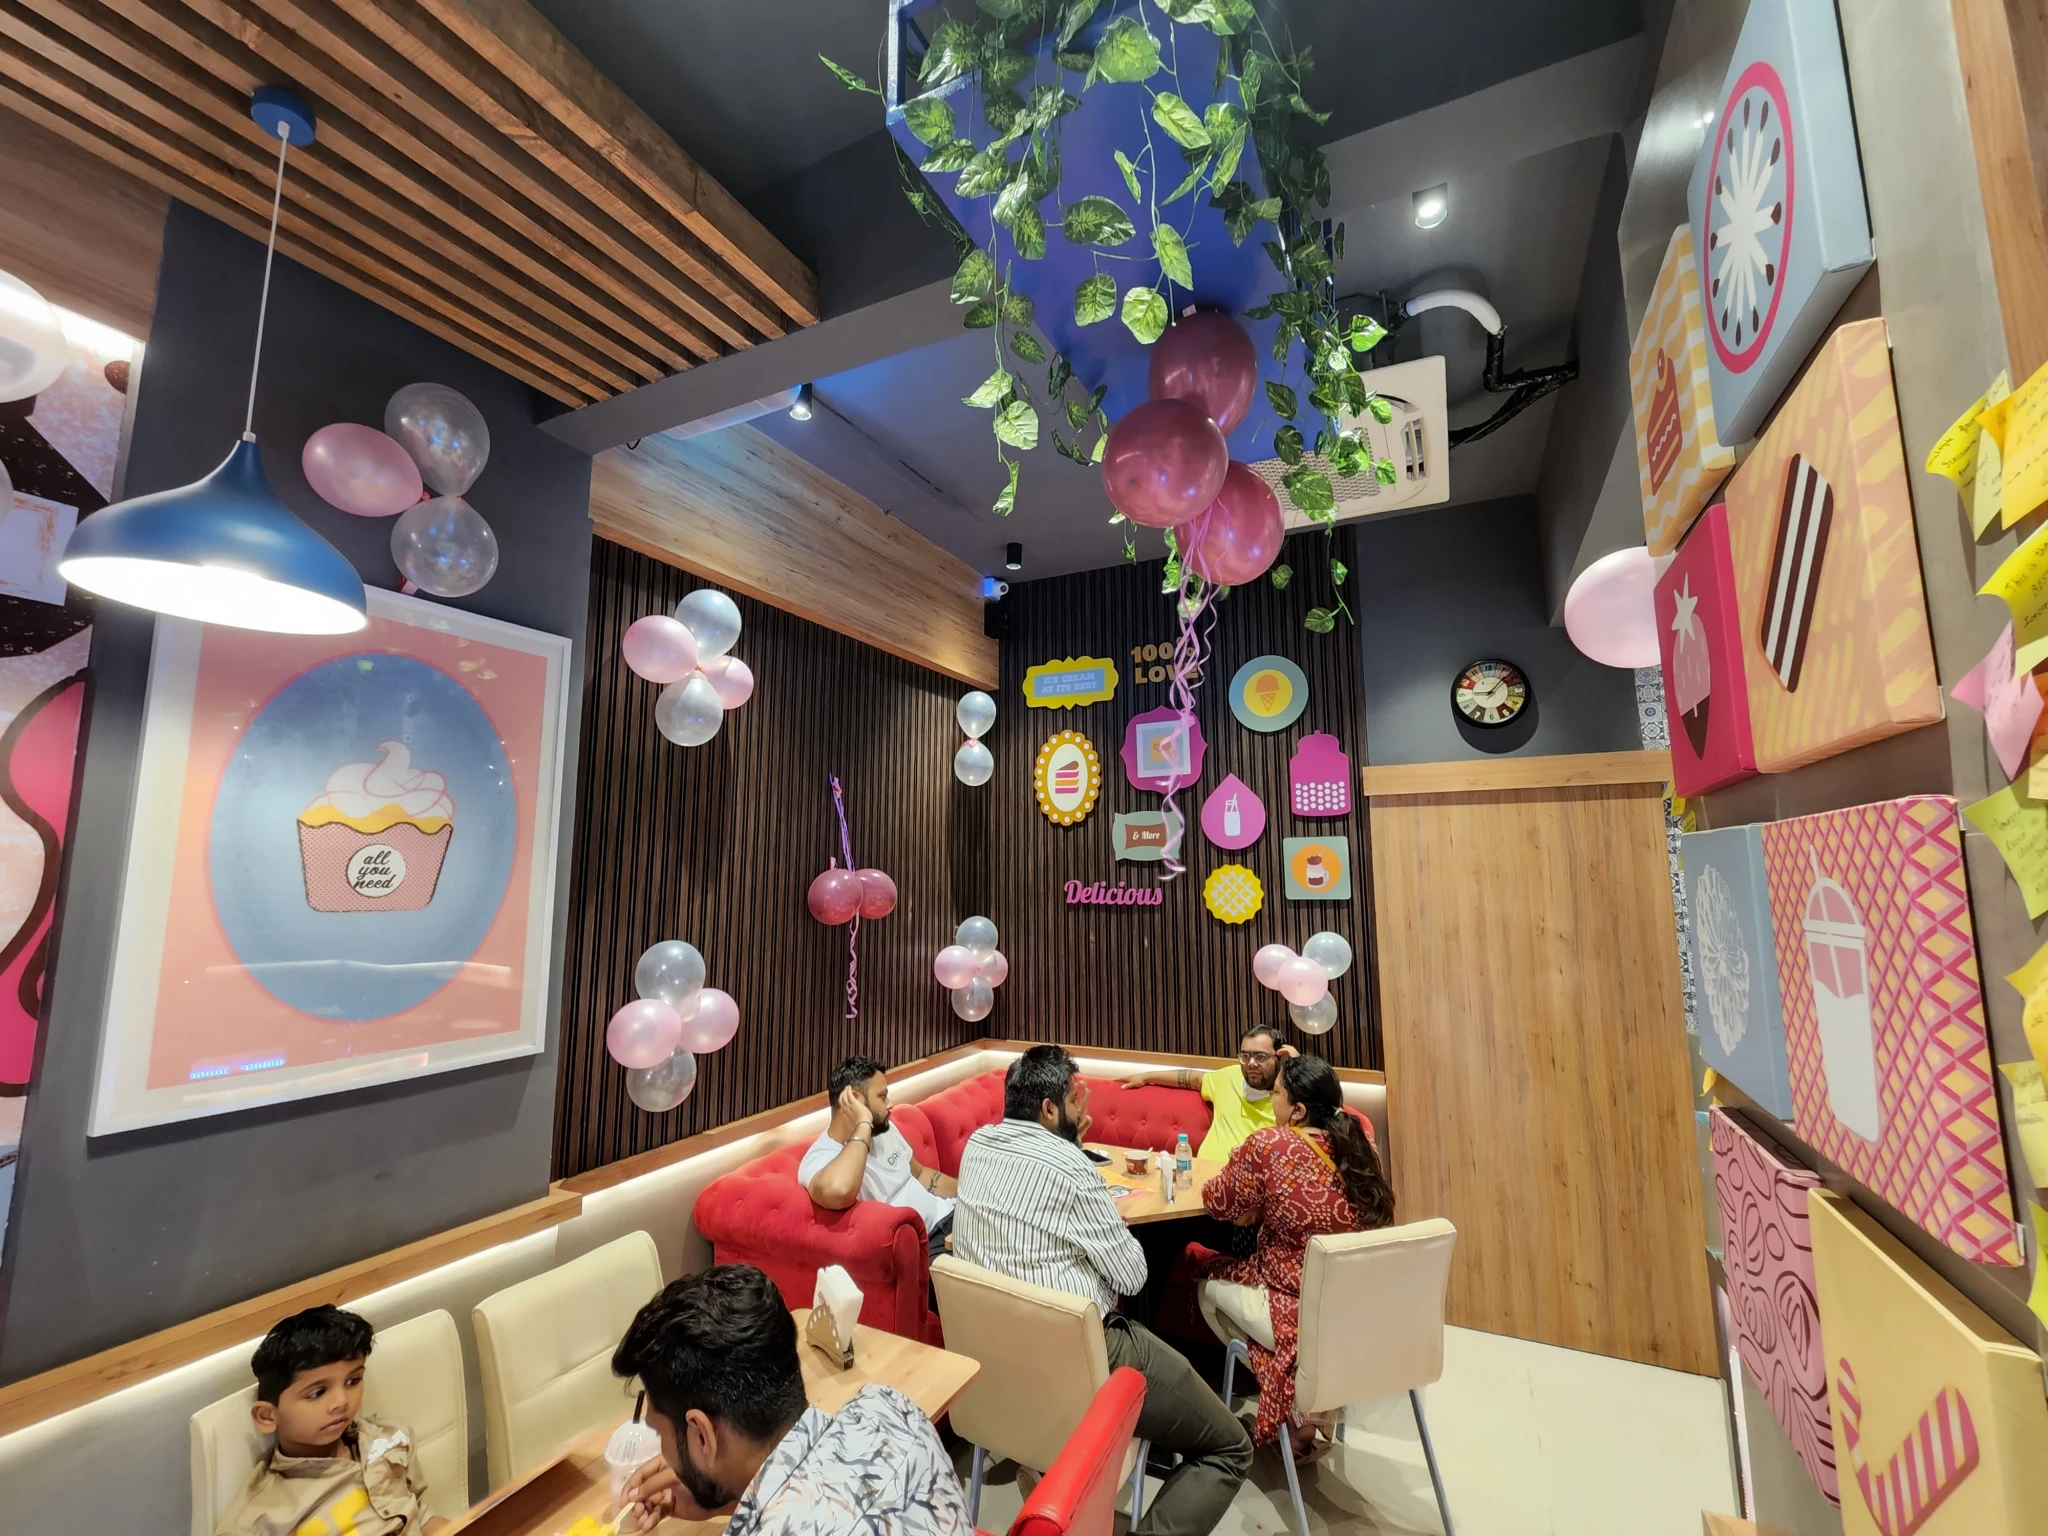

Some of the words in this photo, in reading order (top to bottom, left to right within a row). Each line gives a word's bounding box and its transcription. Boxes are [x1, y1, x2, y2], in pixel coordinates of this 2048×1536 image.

[1485, 664, 1492, 672] 12
[1043, 676, 1059, 685] ICE
[1061, 672, 1095, 682] CREAM
[1041, 685, 1054, 694] AT
[1056, 683, 1072, 692] ITS
[1074, 681, 1098, 691] BEST
[1132, 831, 1139, 840] &
[1141, 830, 1160, 840] More
[363, 850, 392, 865] all
[356, 866, 392, 880] you
[353, 874, 397, 889] need
[1064, 880, 1163, 906] Delicious
